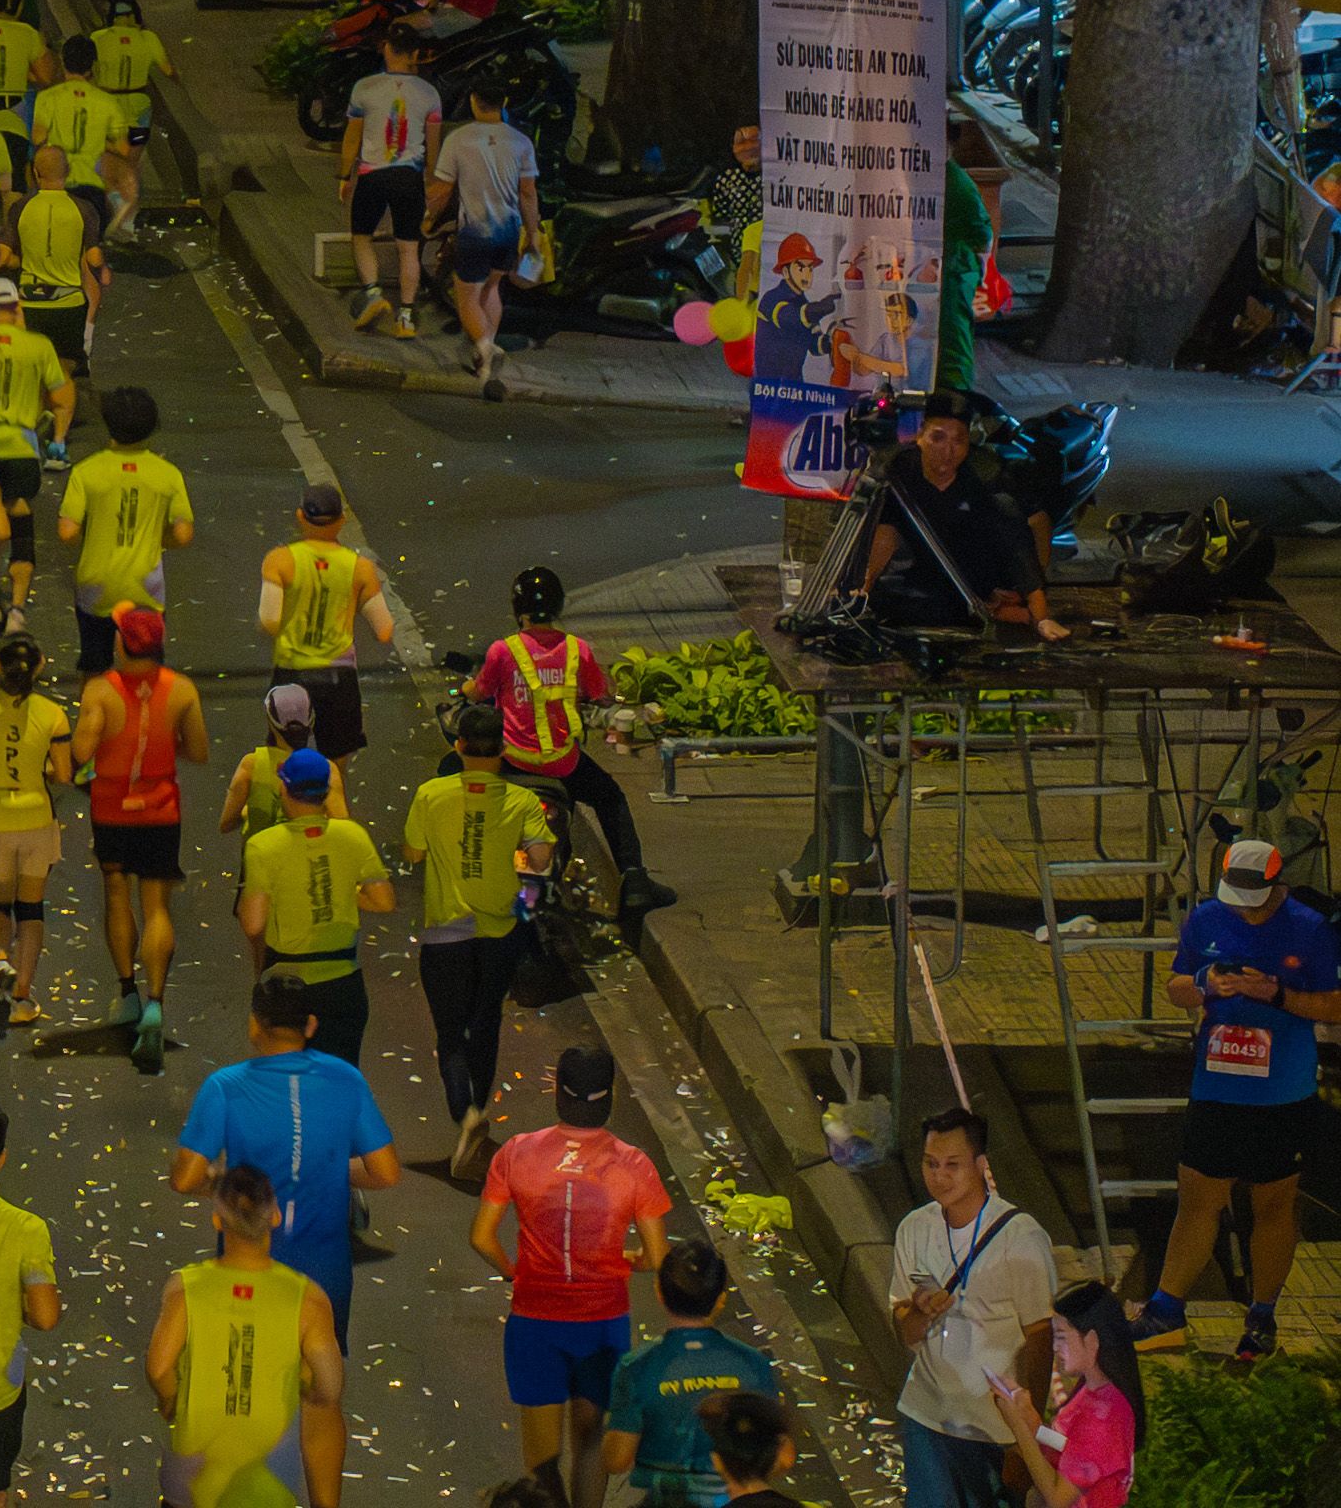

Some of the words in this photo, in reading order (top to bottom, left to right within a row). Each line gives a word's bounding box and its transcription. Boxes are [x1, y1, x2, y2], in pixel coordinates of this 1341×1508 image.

[798, 42, 833, 75] DỤNG
[867, 49, 886, 74] AN
[785, 86, 828, 119] KHÔNG
[848, 91, 884, 123] HÀNG
[776, 132, 799, 167] VẬT
[841, 143, 895, 171] PHƯƠNG
[900, 142, 931, 177] TIỆN
[770, 176, 793, 210] LẤN
[797, 181, 835, 215] CHIẾM
[837, 184, 854, 218] LỐI
[859, 188, 904, 220] THOÁT
[908, 195, 937, 227] NẠN
[753, 382, 776, 400] Bột
[777, 387, 804, 403] Giặt
